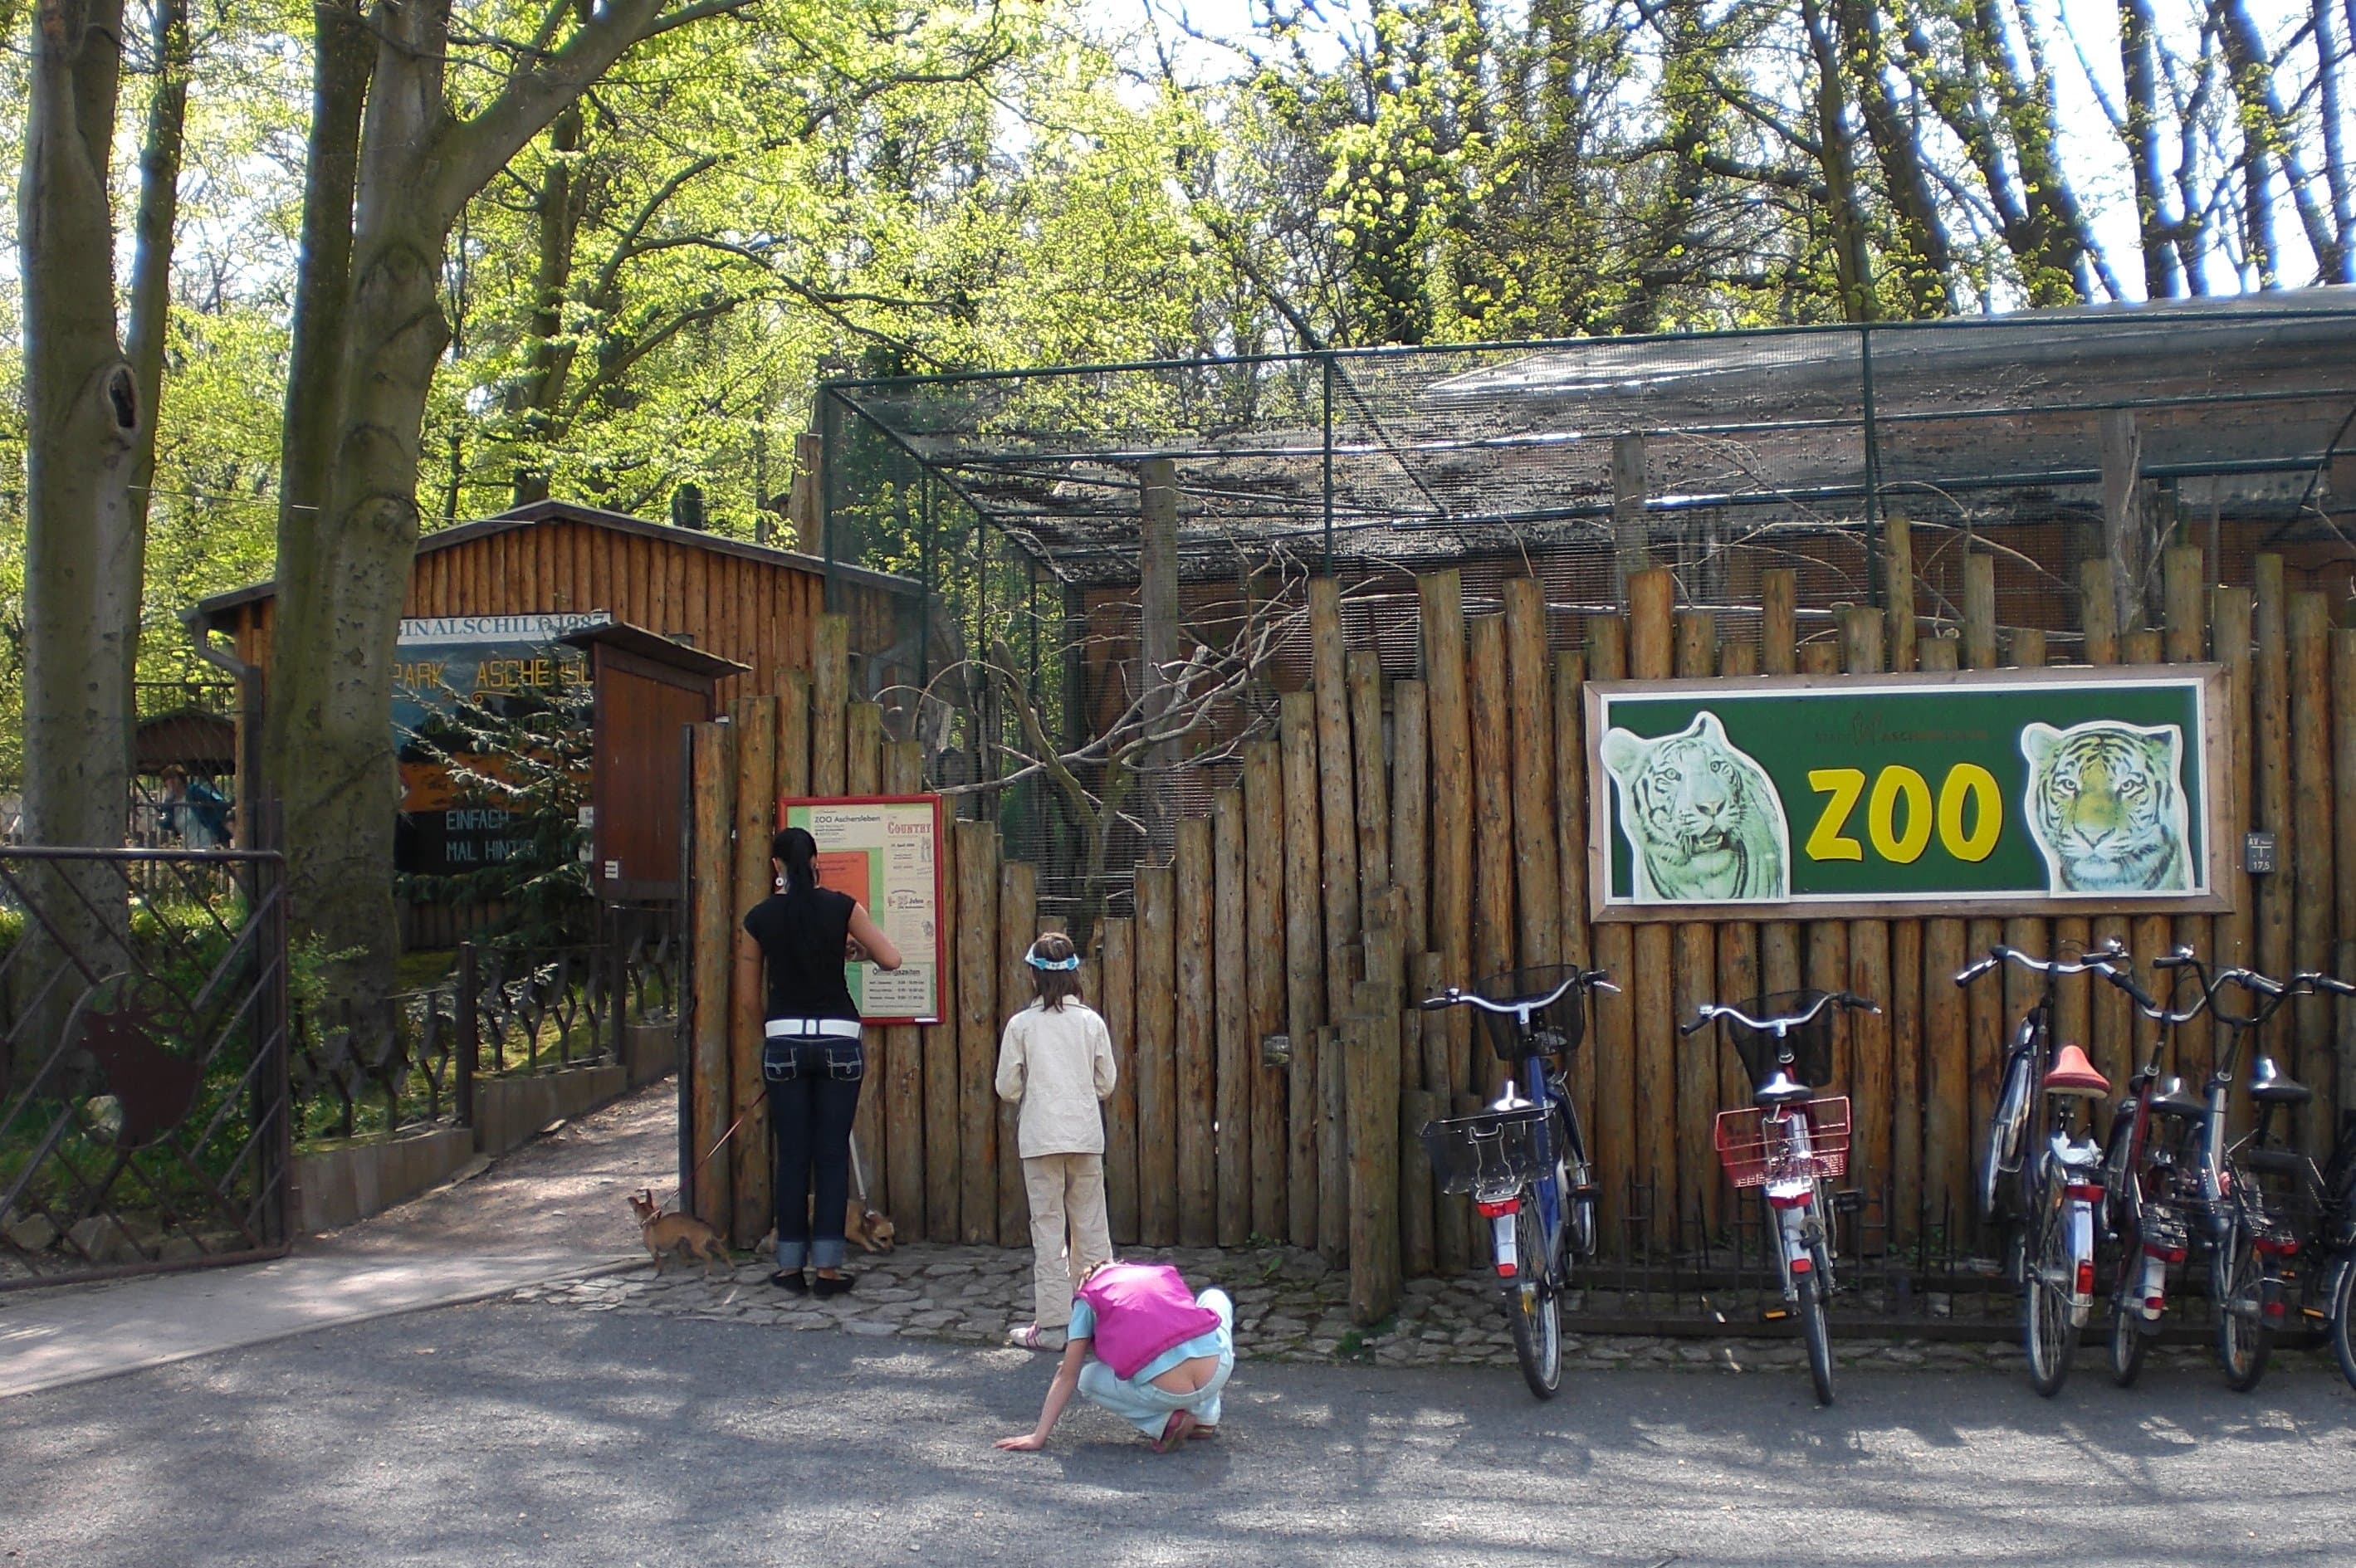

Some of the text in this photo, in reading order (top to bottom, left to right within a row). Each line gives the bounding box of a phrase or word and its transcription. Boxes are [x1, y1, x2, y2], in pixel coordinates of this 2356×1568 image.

[398, 617, 554, 637] INALSCHILD
[476, 659, 594, 688] ASCHESL
[445, 809, 511, 830] EINFACH
[814, 814, 881, 823] ZOO Aschersleben
[1806, 763, 2002, 864] ZOO
[445, 841, 477, 862] MAL
